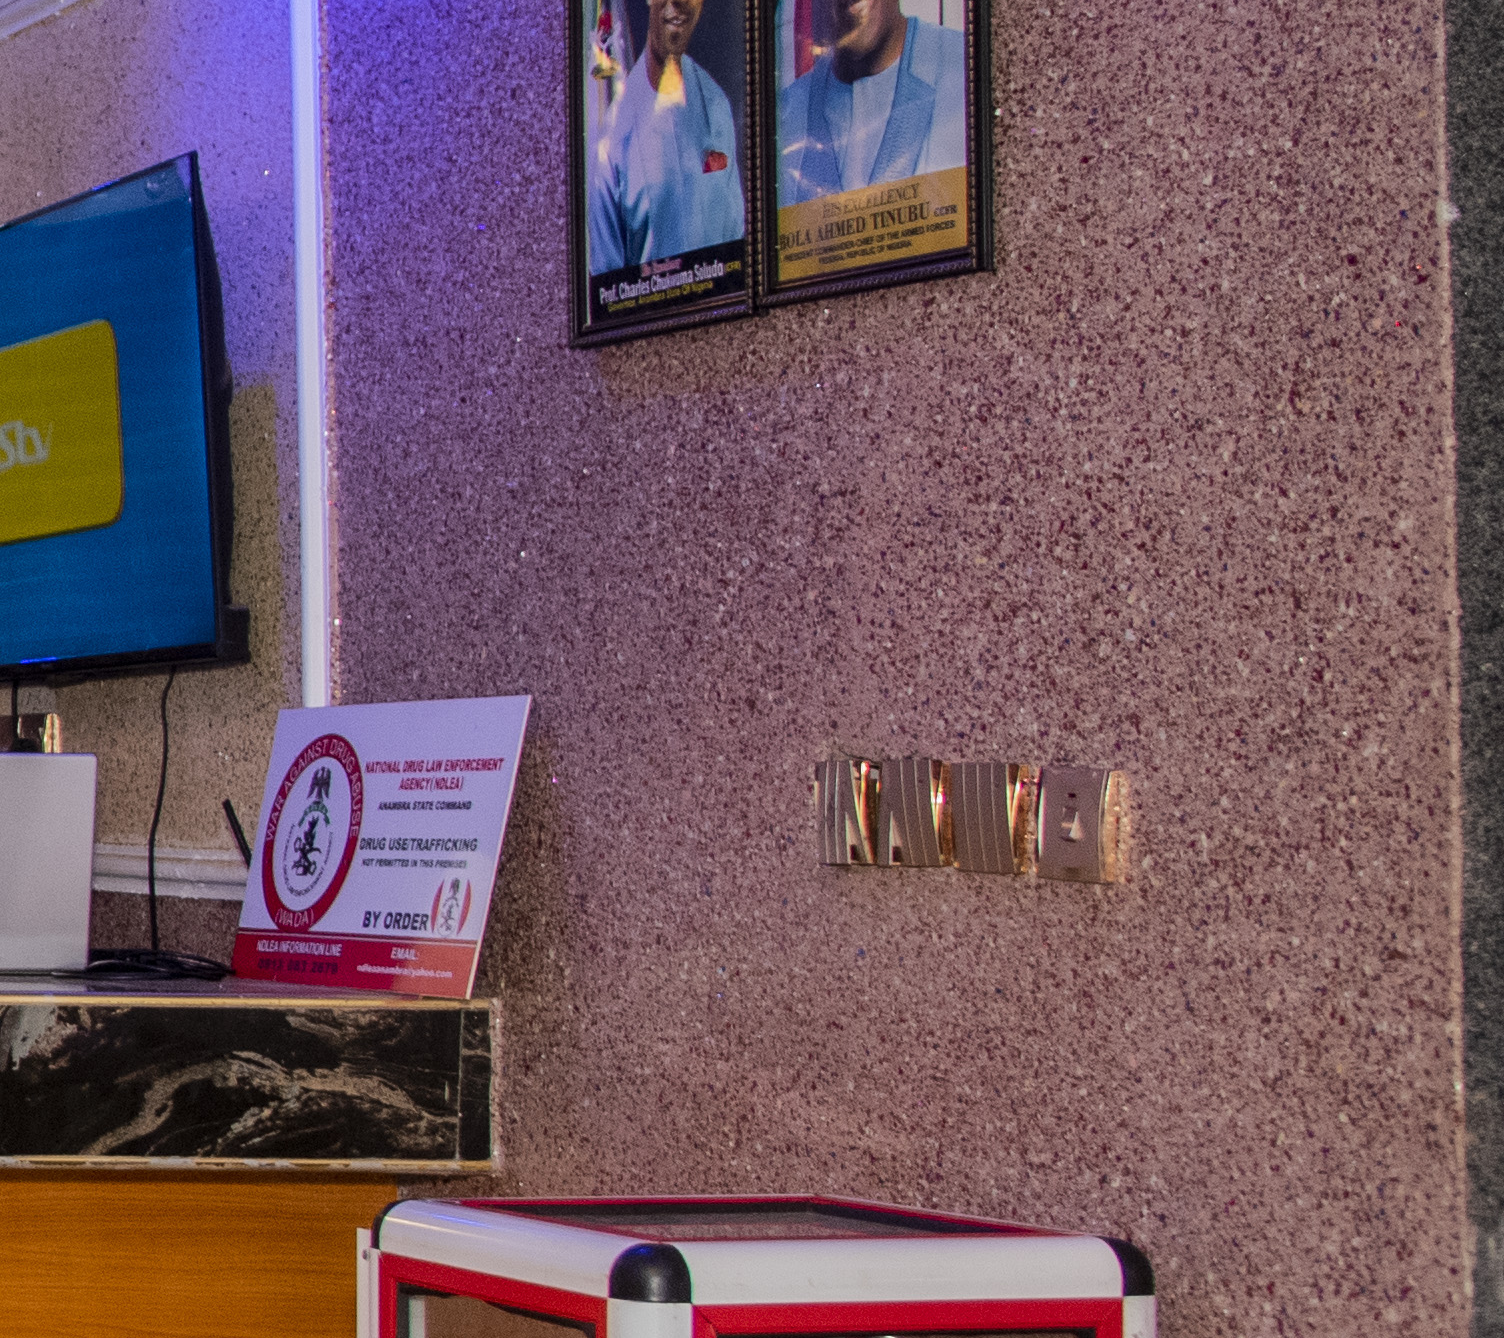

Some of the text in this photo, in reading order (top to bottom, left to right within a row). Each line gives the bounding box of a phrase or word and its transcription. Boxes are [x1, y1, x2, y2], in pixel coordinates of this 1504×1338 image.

[816, 215, 866, 242] AHMED
[869, 200, 931, 231] TINUBU
[365, 757, 506, 774] NATIONAL DRUG LAW ENFORCEMENT
[266, 738, 362, 841] WAR AGAINST DRUG ABUSE
[412, 800, 434, 811] STATE
[434, 800, 473, 811] COMMAND
[359, 836, 387, 851] DRUG
[361, 910, 430, 932] BY ORDER
